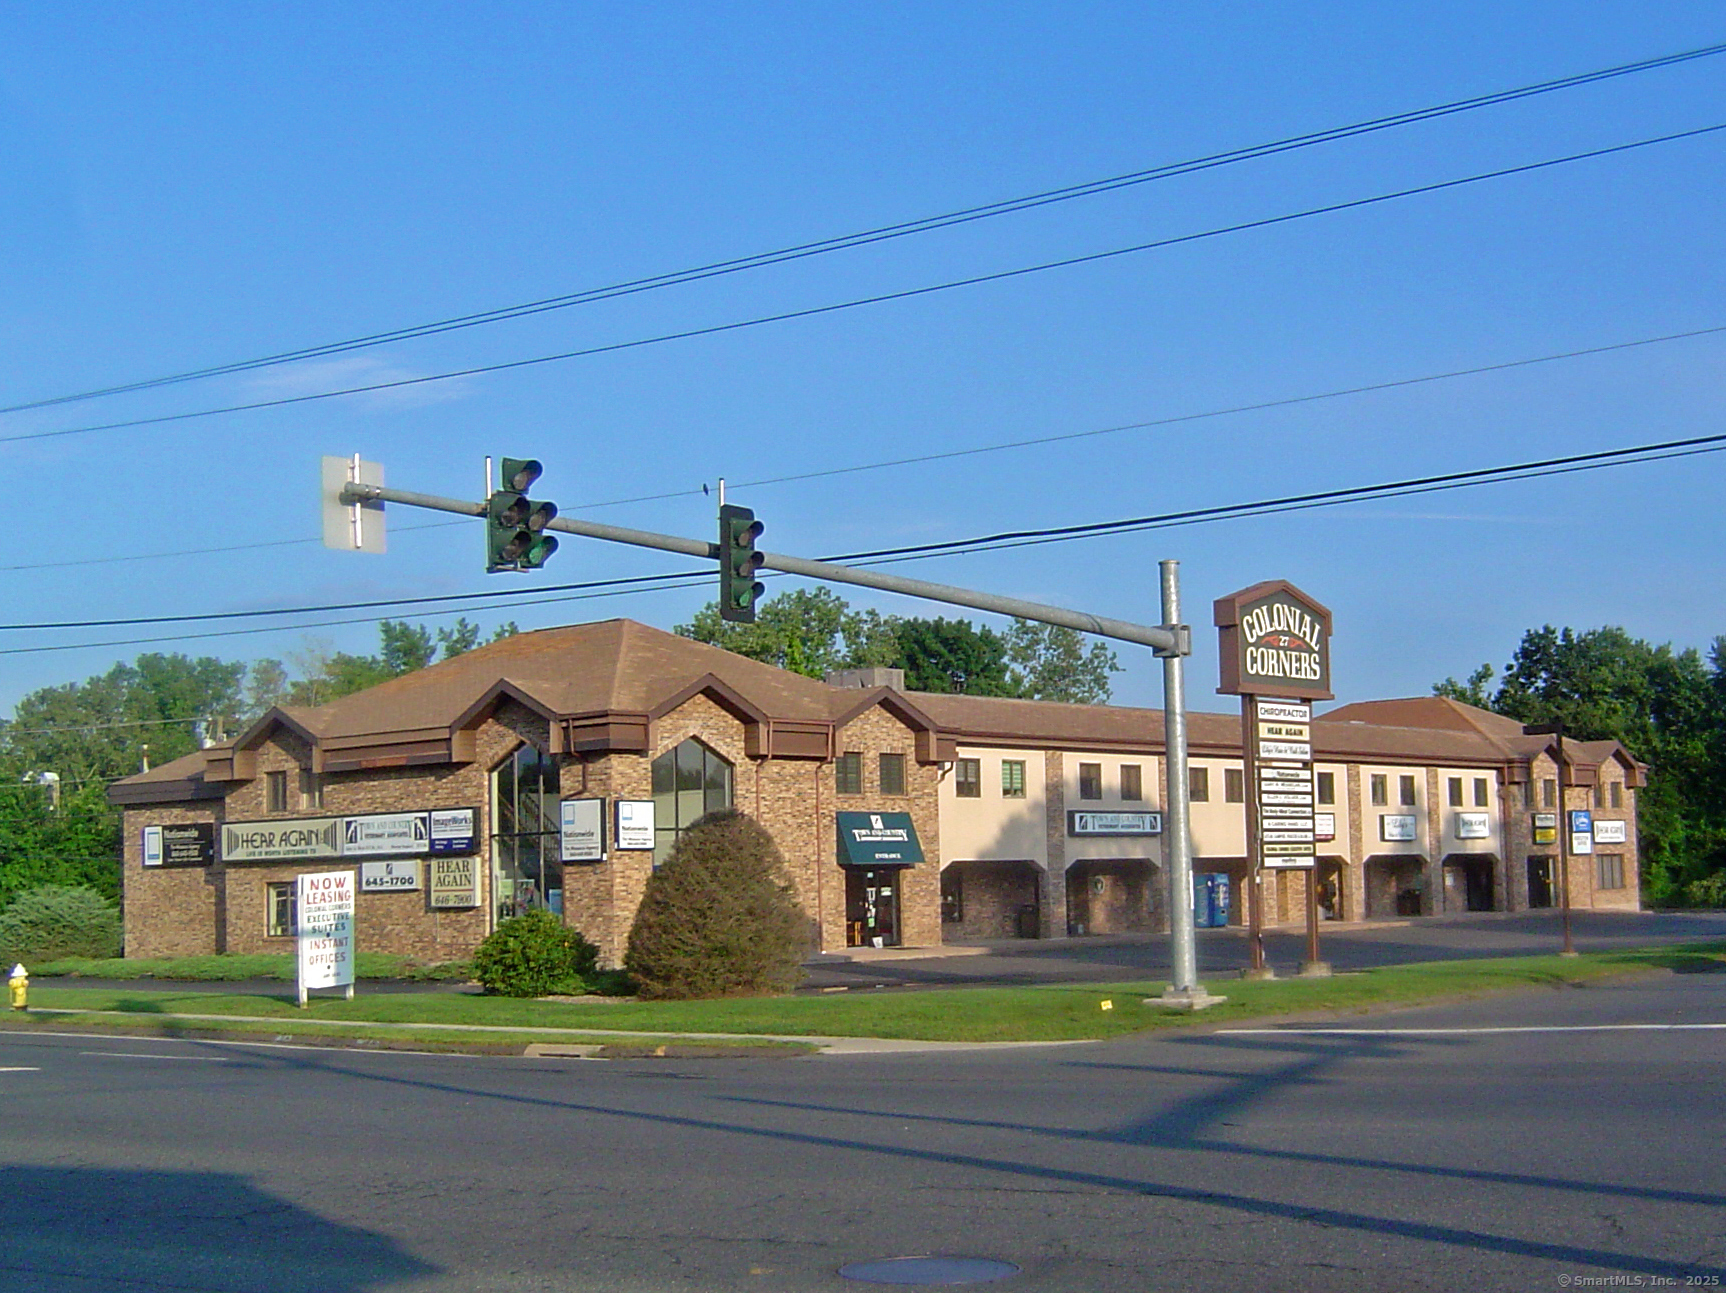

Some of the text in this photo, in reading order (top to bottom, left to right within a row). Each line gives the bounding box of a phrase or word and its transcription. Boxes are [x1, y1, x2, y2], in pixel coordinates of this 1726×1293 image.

[1243, 603, 1321, 651] COLONIAL
[1279, 635, 1289, 647] 27
[1246, 646, 1320, 680] CORNERS
[1260, 707, 1307, 718] CHIROPRACTOR
[1285, 728, 1303, 736] AGAIN
[240, 828, 319, 849] HEAR AGAIN
[563, 829, 594, 838] Nationwide
[437, 860, 470, 874] HEAR
[310, 876, 346, 891] NOW
[365, 876, 415, 886] 645-1700
[435, 874, 472, 887] AGAIN
[306, 890, 352, 905] LEASING
[307, 912, 350, 924] EXECUTIVE
[311, 922, 346, 934] SUITES
[310, 936, 348, 950] INSTANT
[309, 952, 346, 966] OFFICES
